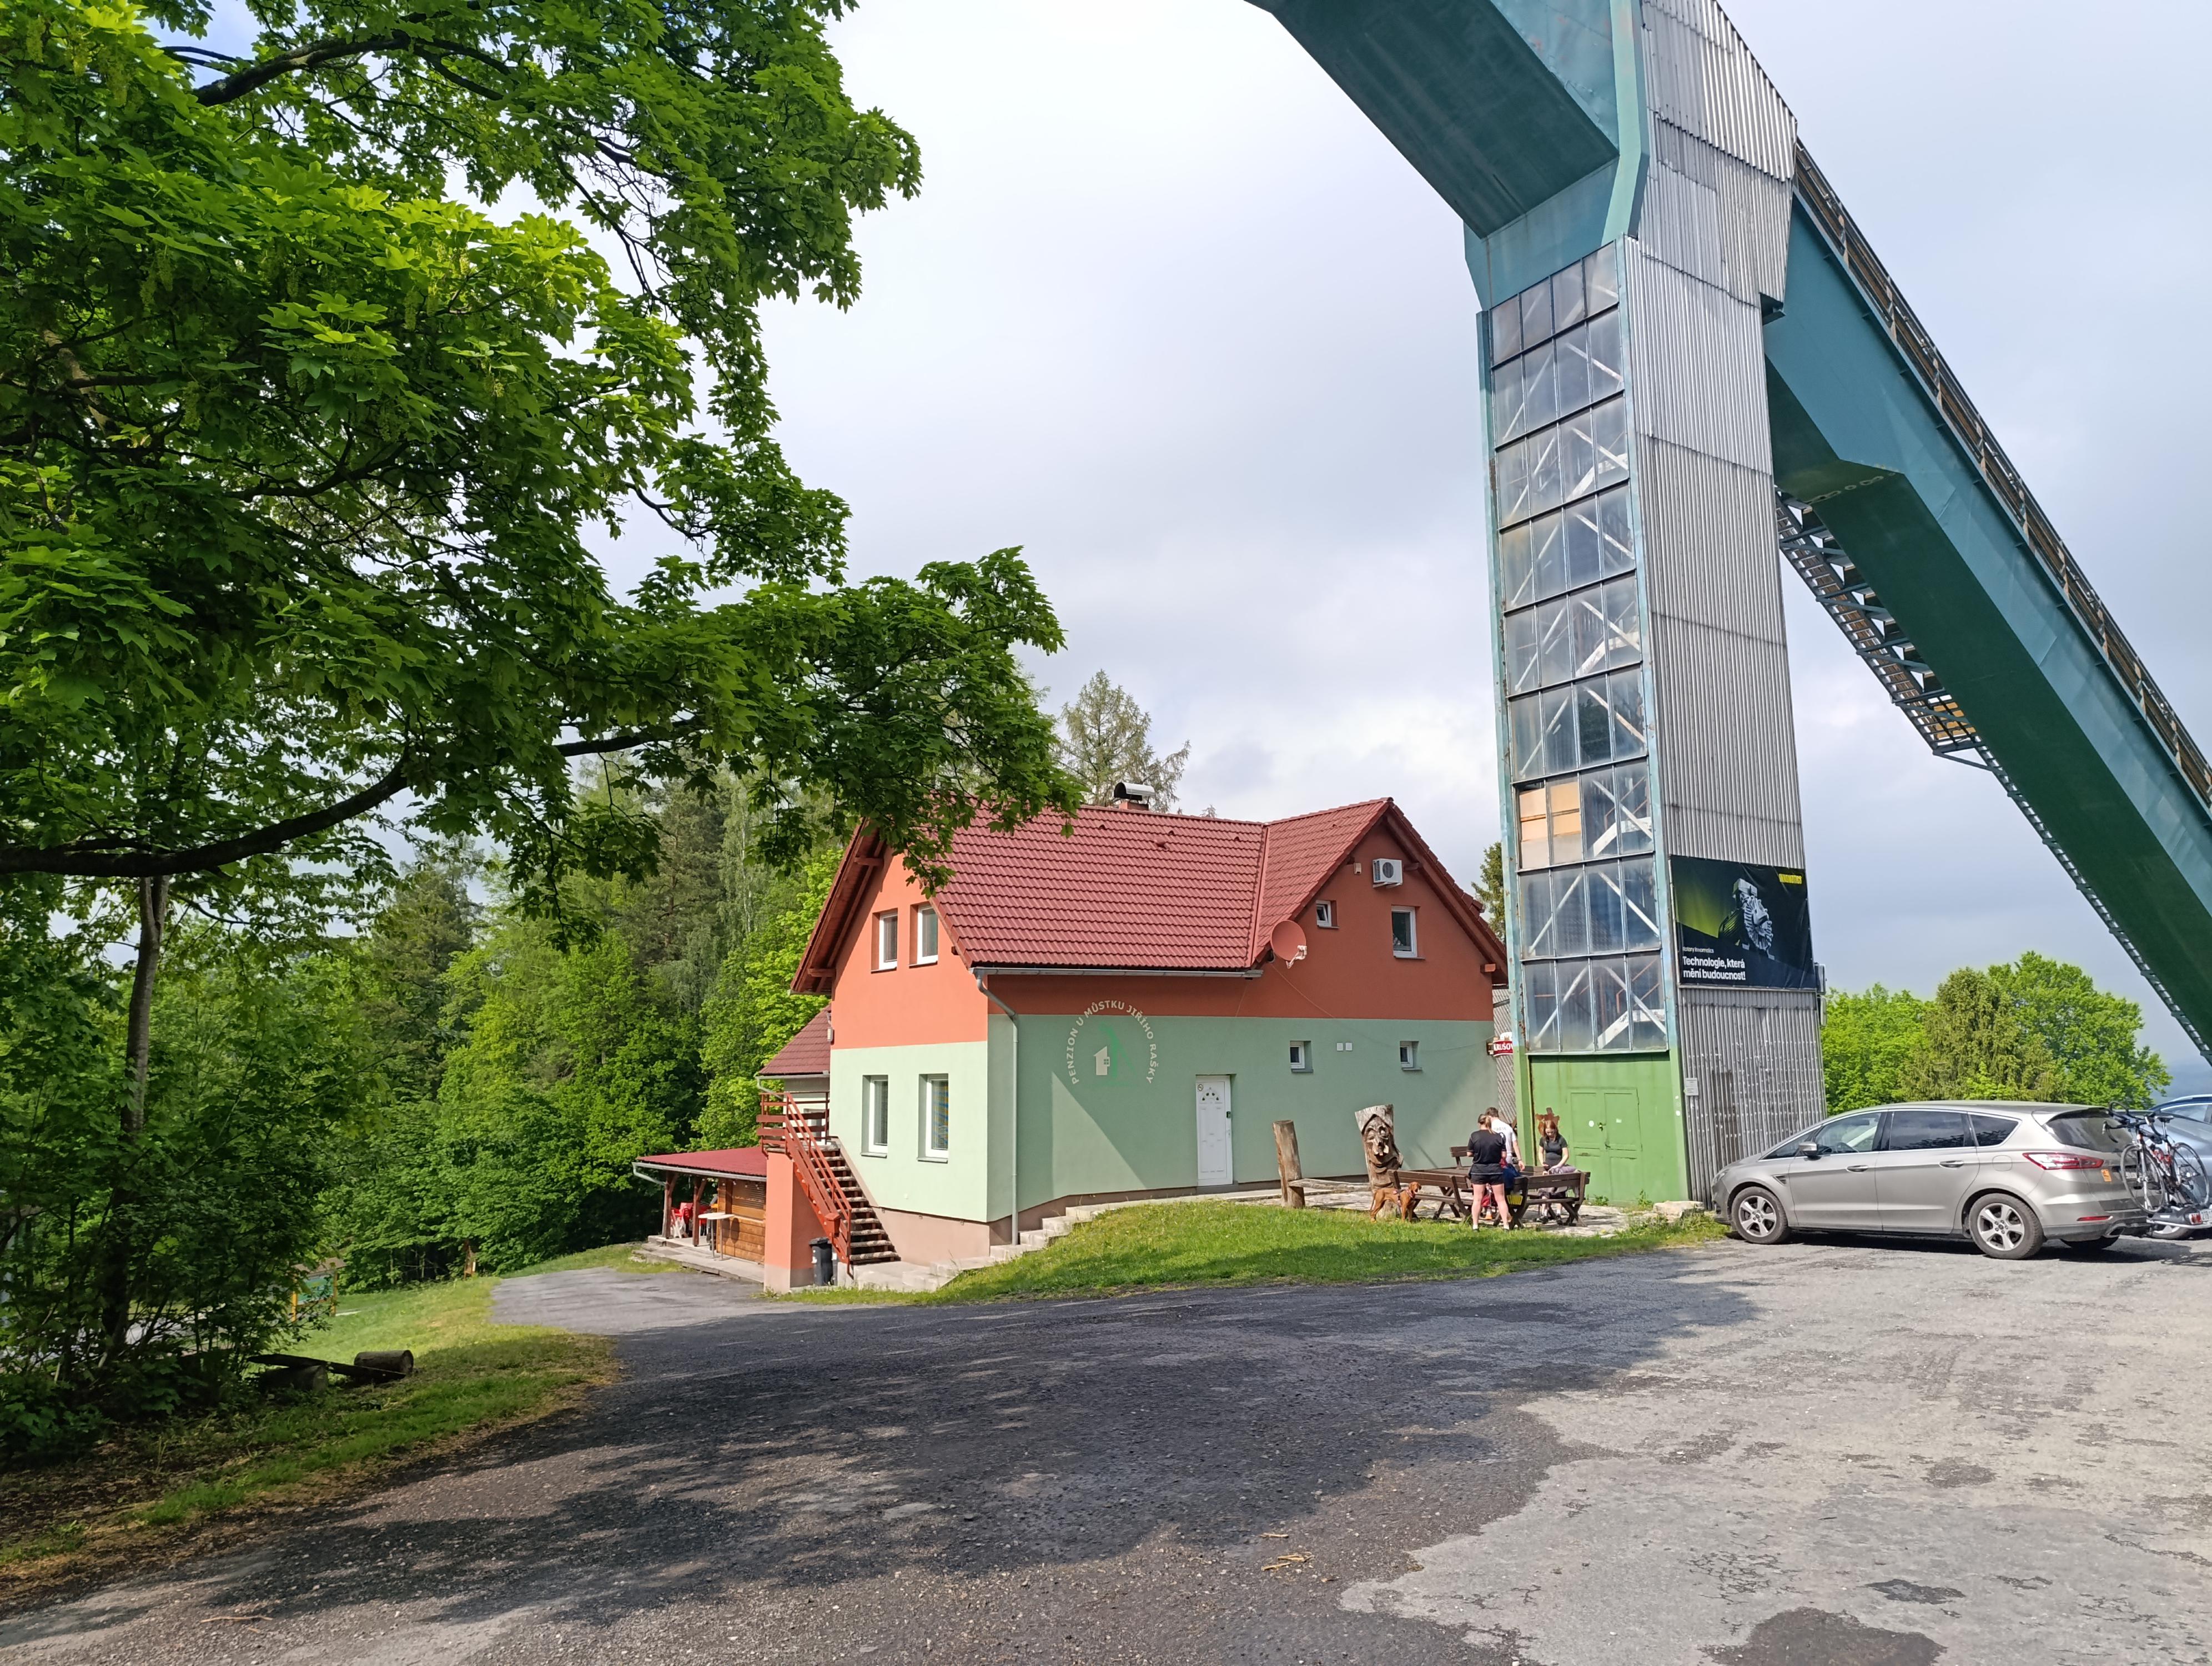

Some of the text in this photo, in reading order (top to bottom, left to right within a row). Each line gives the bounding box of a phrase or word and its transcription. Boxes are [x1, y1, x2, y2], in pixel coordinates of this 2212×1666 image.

[1682, 956, 1745, 969] Technologie, která
[1683, 968, 1746, 980] mění budoucnost!
[1066, 1000, 1159, 1085] PENZION U MŮSTKU JIŘÍHO RAŠKY
